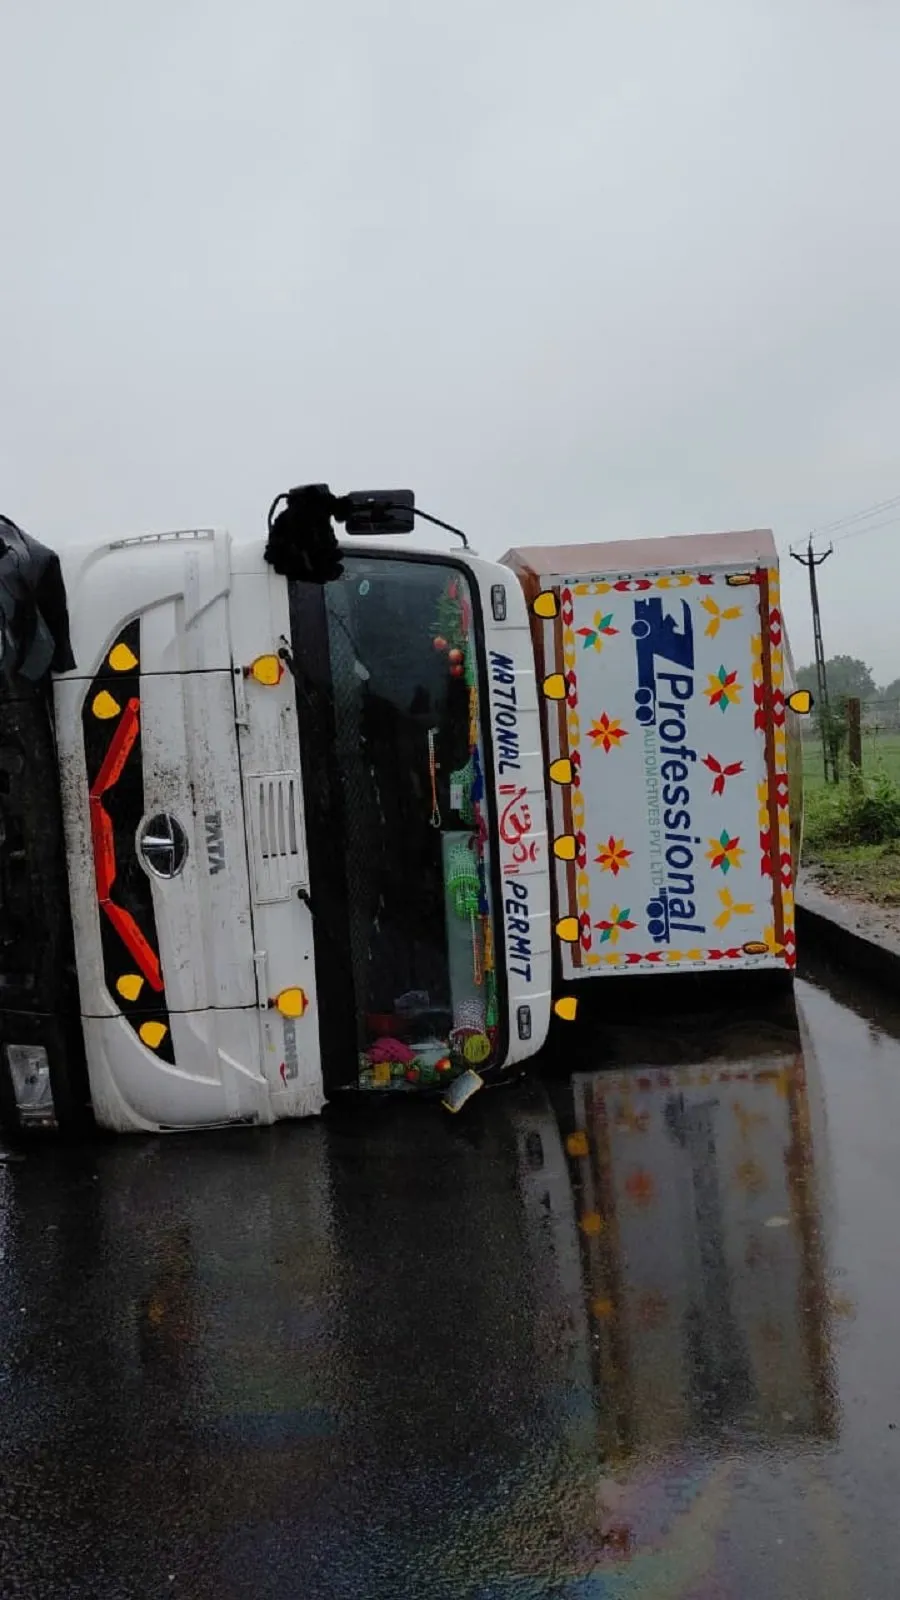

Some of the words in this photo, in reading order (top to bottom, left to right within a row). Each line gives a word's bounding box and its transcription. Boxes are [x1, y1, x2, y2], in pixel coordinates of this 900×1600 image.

[205, 810, 226, 875] TATA
[489, 651, 521, 775] NATIONAL
[505, 880, 532, 983] PERMIT
[643, 728, 661, 827] AUTOMOTIVES
[656, 672, 706, 934] Professional
